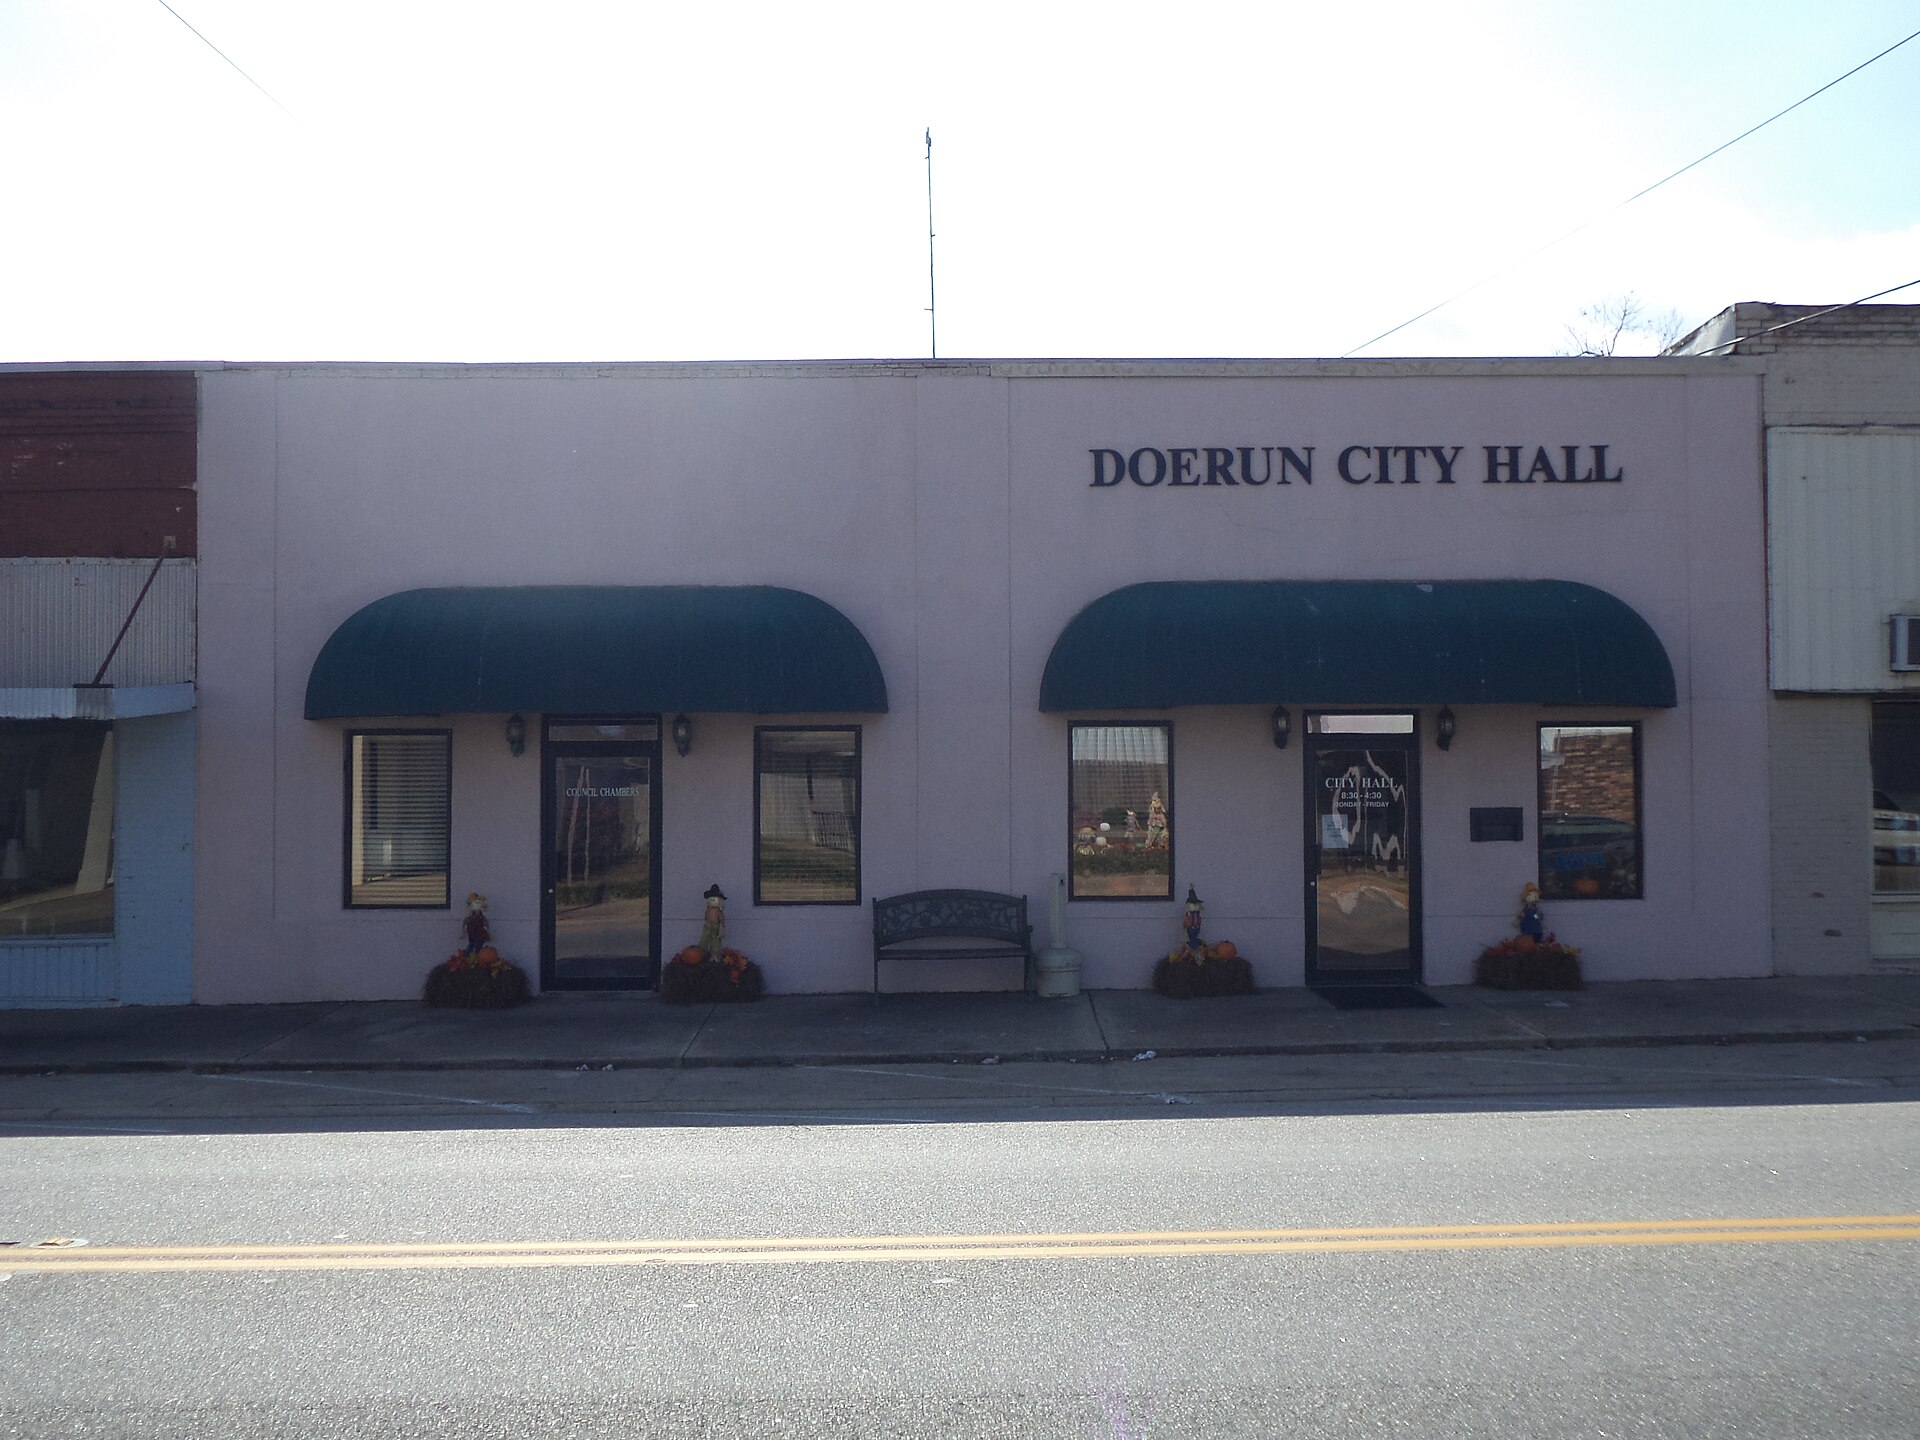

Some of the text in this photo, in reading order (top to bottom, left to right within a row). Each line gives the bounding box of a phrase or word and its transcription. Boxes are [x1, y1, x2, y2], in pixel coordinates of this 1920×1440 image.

[1088, 444, 1623, 487] DOERUN CITY HALL
[1325, 777, 1398, 789] CITY HALL
[566, 787, 640, 797] COUNCIL CHAMBERS
[1364, 791, 1382, 799] 4:30
